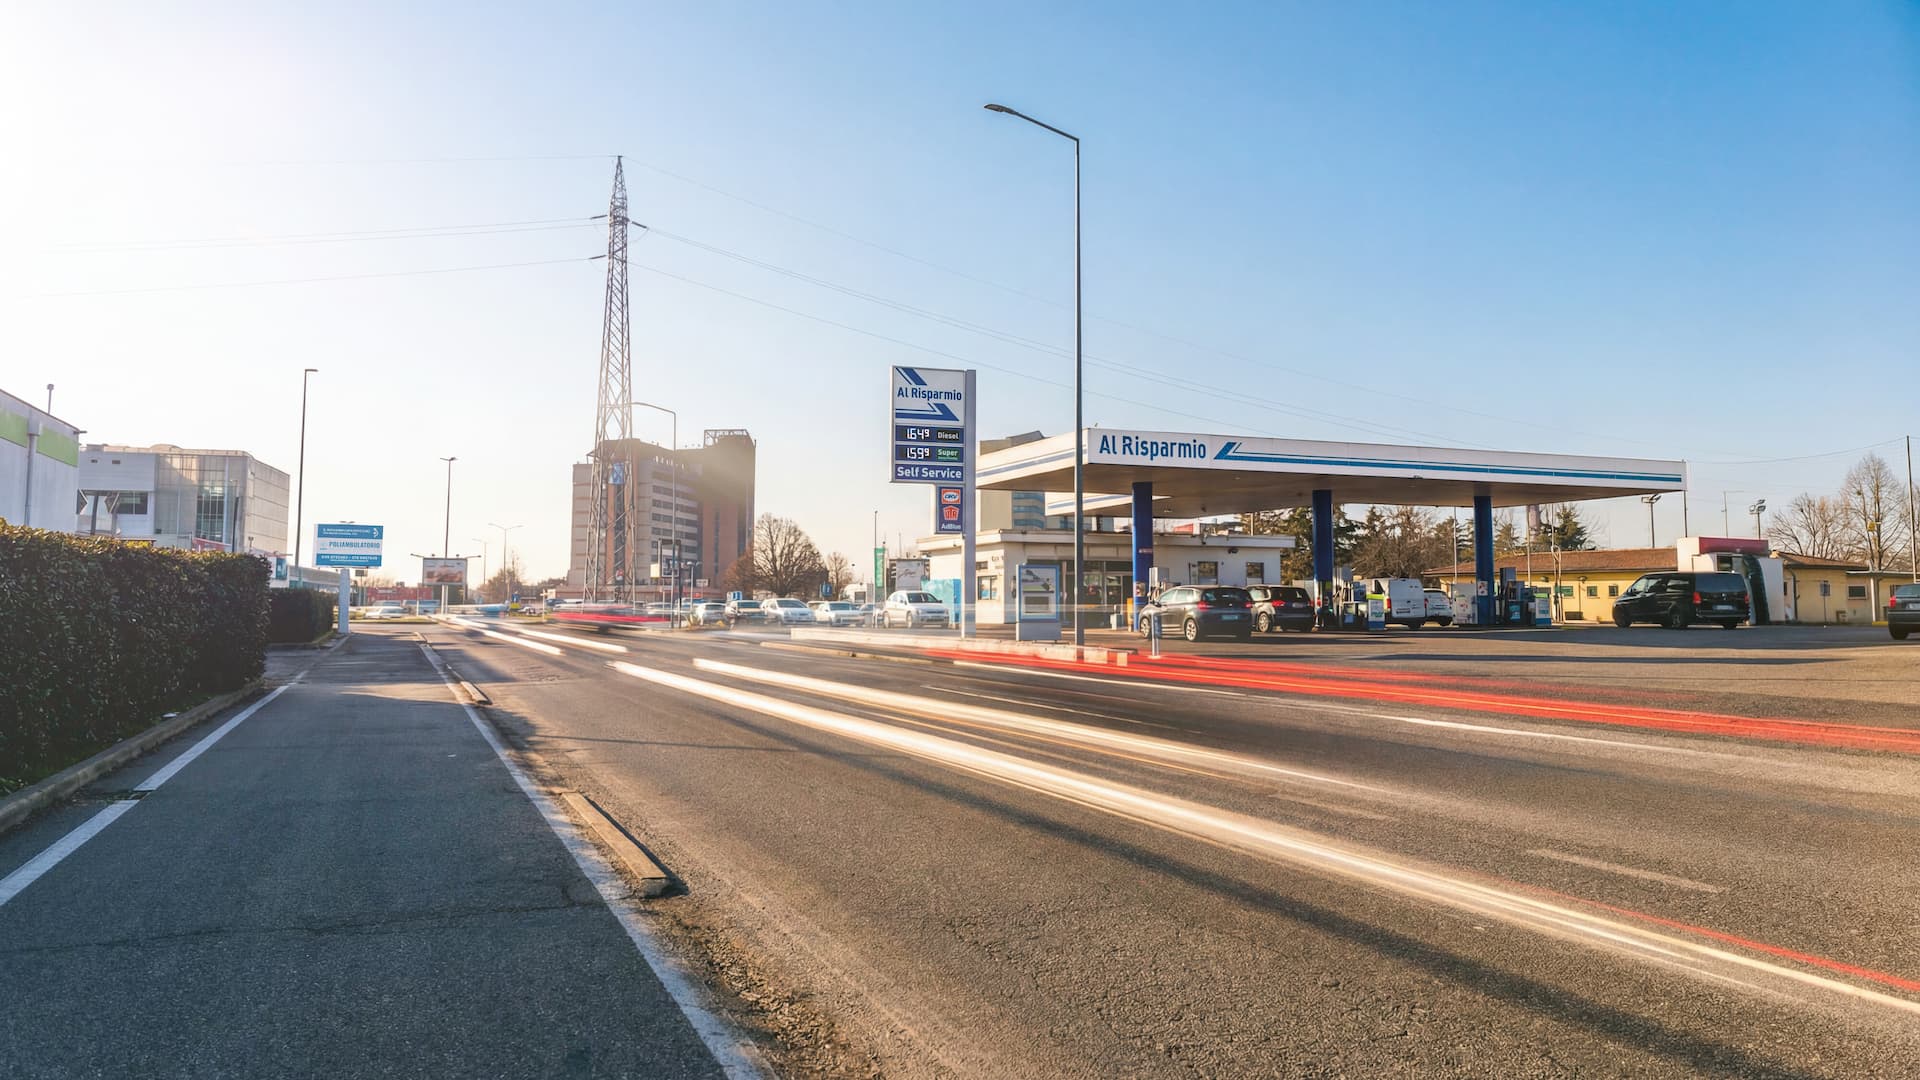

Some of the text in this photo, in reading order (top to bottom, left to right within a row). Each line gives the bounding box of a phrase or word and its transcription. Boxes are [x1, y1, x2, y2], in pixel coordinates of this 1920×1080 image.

[897, 387, 962, 401] Al Risparmio
[937, 432, 959, 440] Diesel
[937, 448, 959, 457] Super
[1099, 435, 1206, 461] Al Risparmio
[897, 466, 962, 479] Self Service
